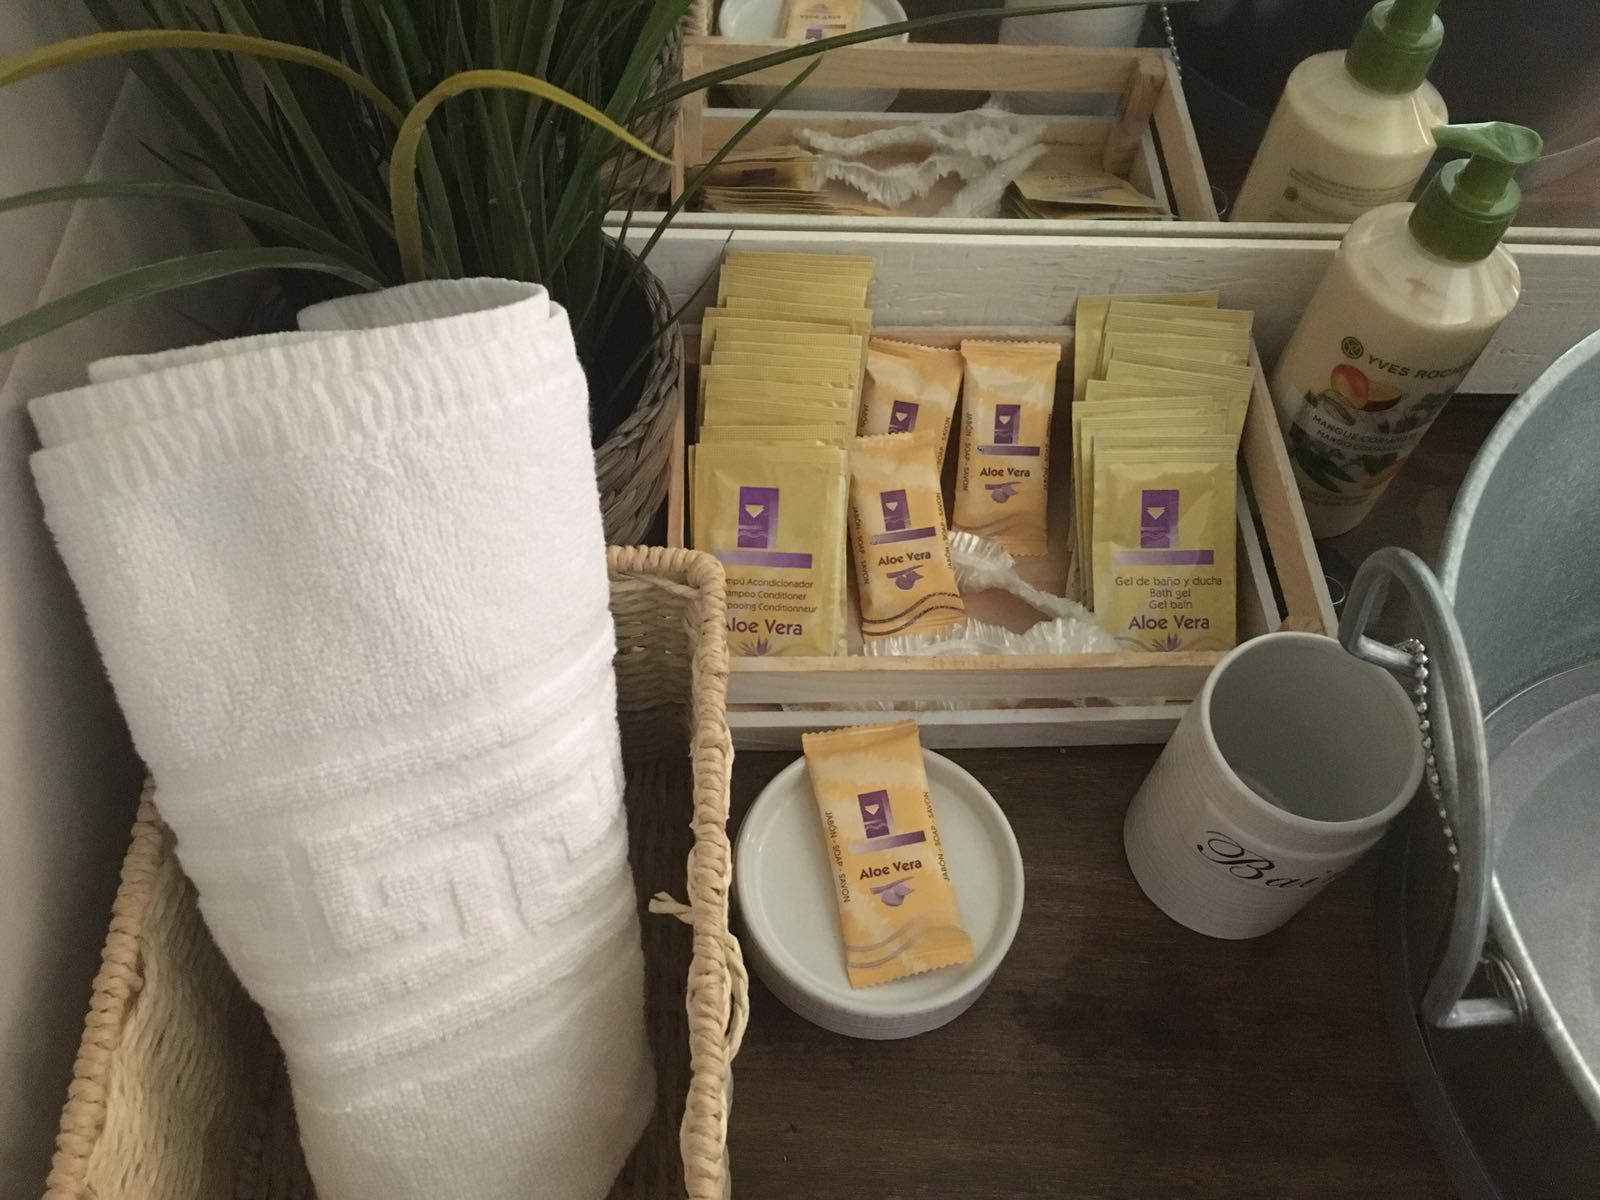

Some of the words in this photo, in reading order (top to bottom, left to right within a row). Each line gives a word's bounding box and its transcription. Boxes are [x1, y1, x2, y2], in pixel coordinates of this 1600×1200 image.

[1368, 355, 1410, 376] YVES
[1312, 415, 1359, 440] MANGUE
[979, 467, 1004, 478] Aloe
[1007, 467, 1031, 478] Vera
[878, 553, 904, 567] Aloe
[906, 550, 931, 562] Vera
[747, 578, 813, 588] Acondicionador
[1115, 576, 1133, 586] Gel
[1137, 576, 1150, 586] de
[1153, 576, 1180, 586] baño
[1182, 578, 1190, 588] y
[1192, 576, 1222, 586] ducha
[758, 590, 807, 601] Conditioner
[1150, 588, 1172, 598] Bath
[1175, 588, 1191, 600] gel
[758, 602, 817, 614] Conditionneur
[1149, 600, 1168, 610] Gel
[1170, 600, 1193, 610] bain
[764, 619, 803, 635] Vera
[1128, 615, 1168, 630] Aloe
[1173, 615, 1210, 630] Vera
[922, 791, 934, 818] SAVON
[930, 825, 941, 847] SOAP
[825, 811, 838, 838] JABÓN
[832, 845, 843, 867] SOAP
[838, 873, 851, 903] SAVON
[859, 867, 890, 880] Aloe
[892, 858, 922, 872] Vera
[937, 853, 950, 881] JABÓN
